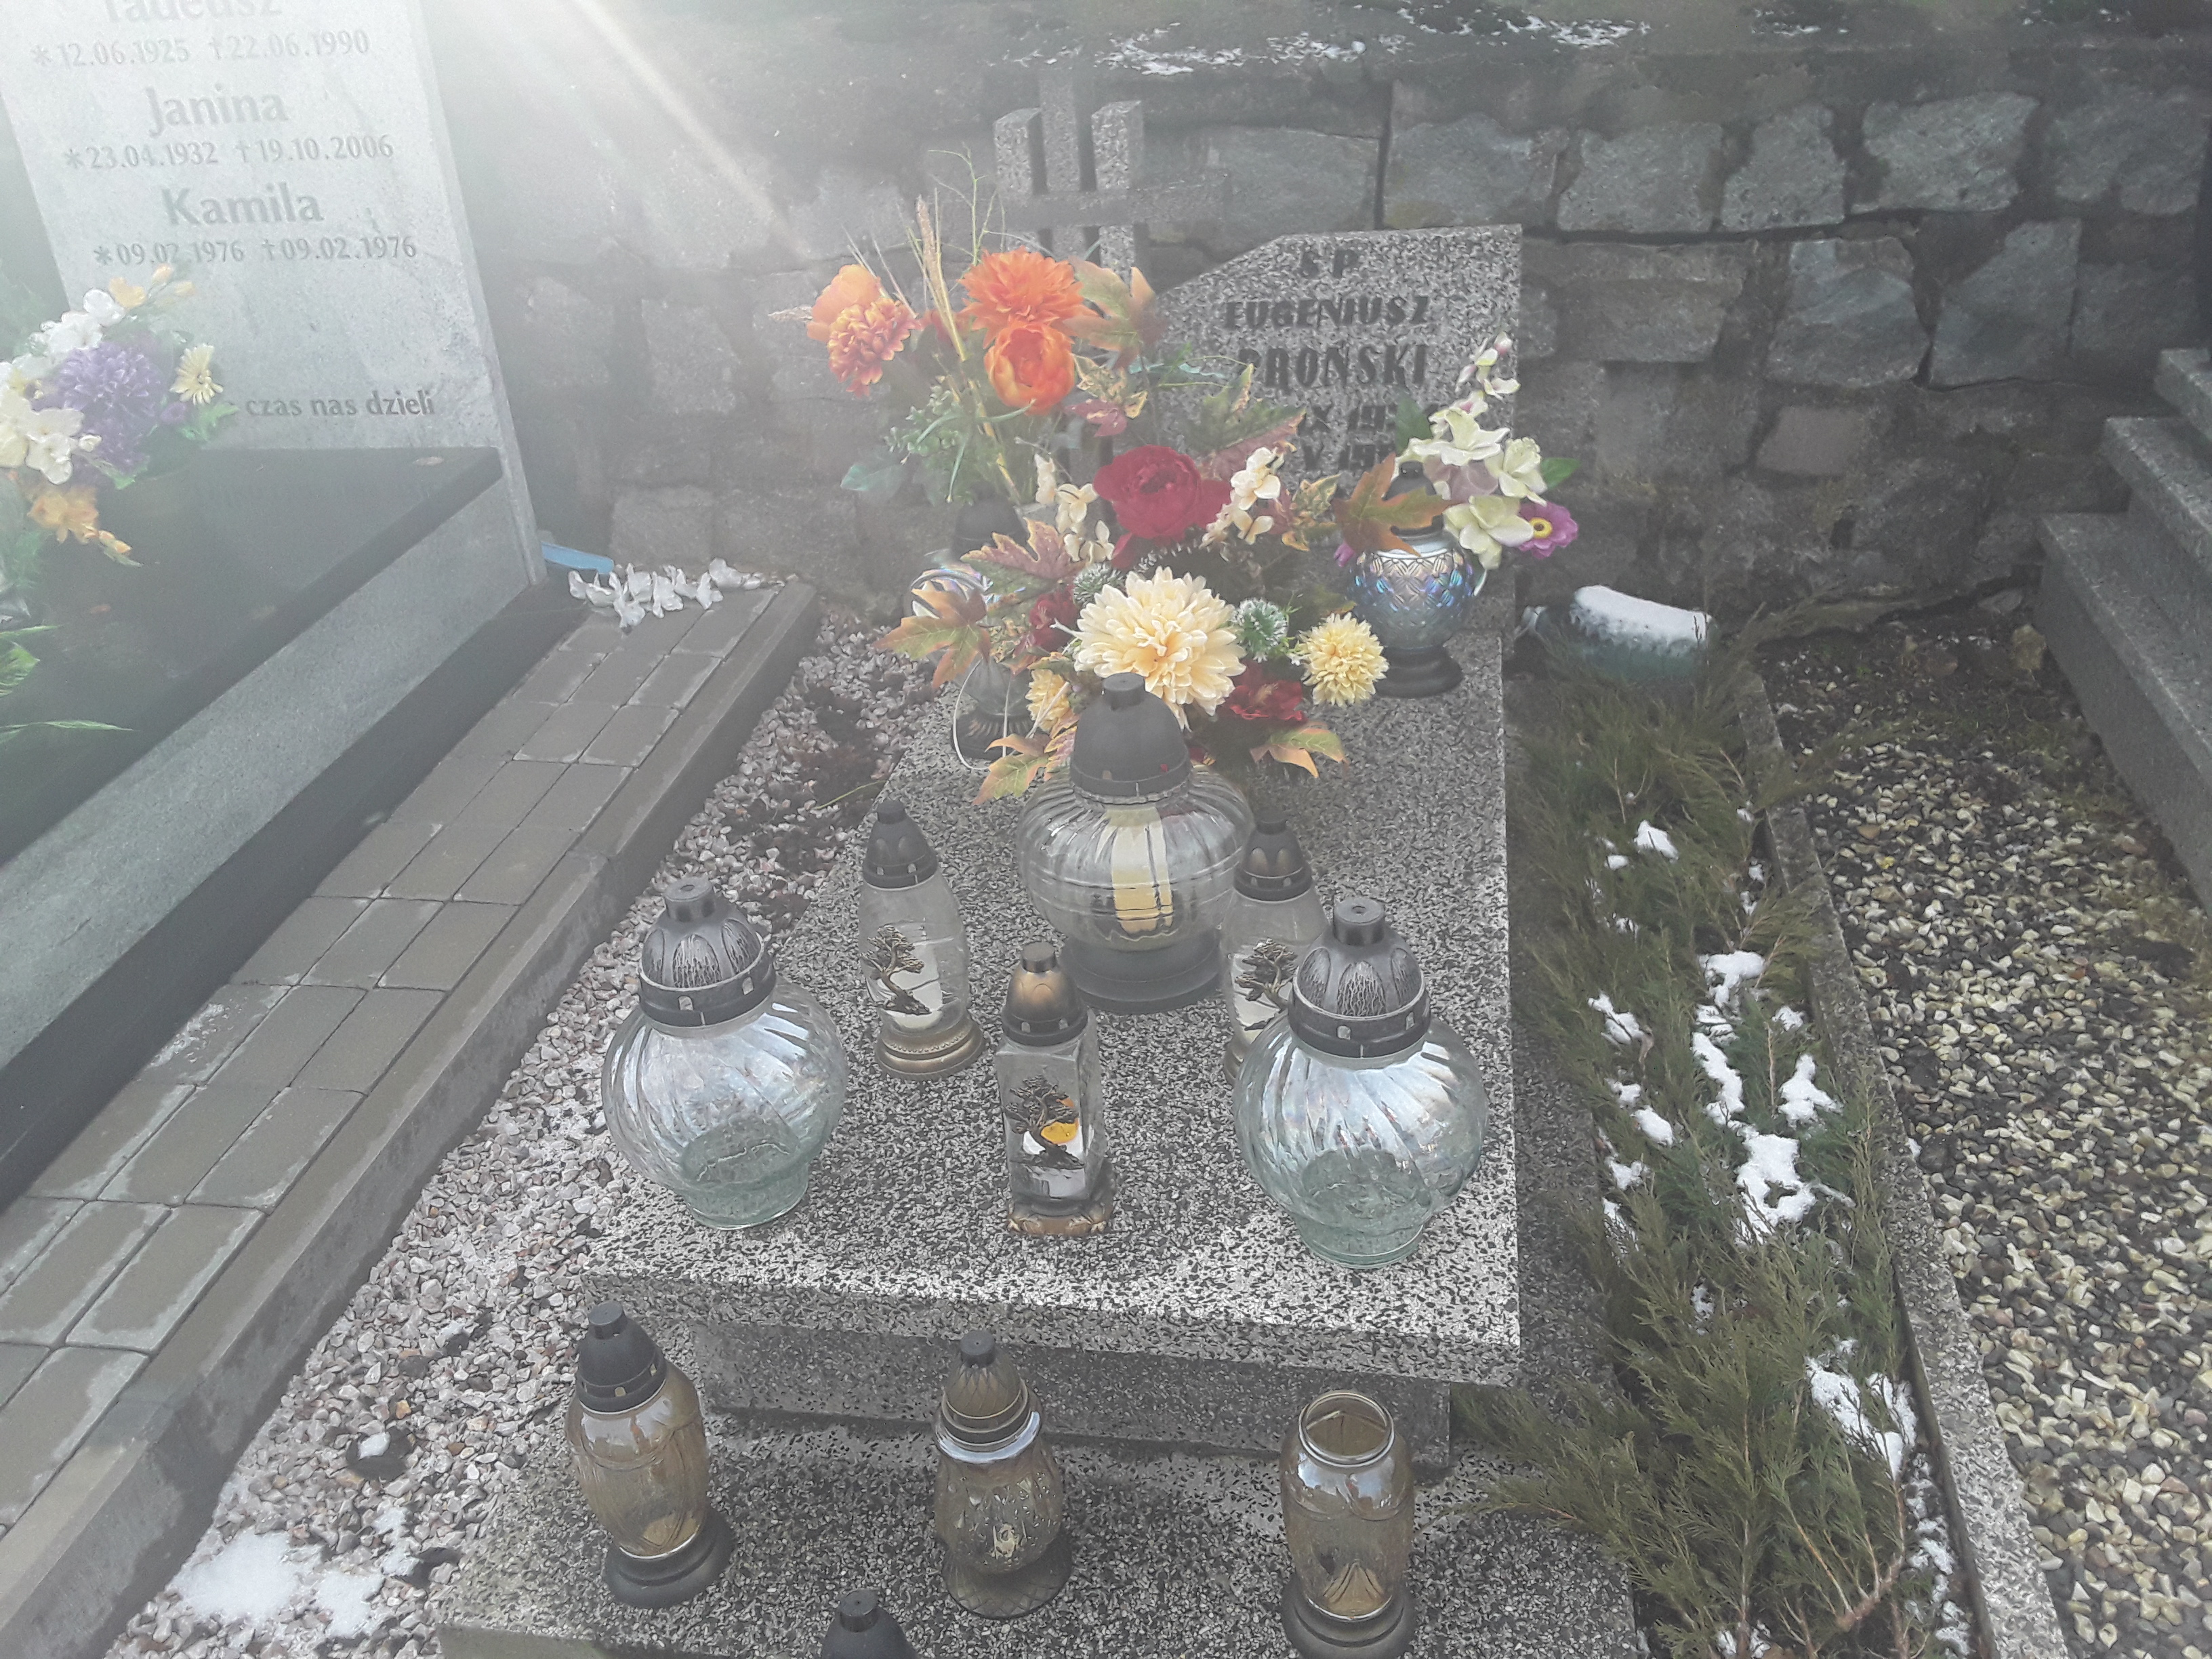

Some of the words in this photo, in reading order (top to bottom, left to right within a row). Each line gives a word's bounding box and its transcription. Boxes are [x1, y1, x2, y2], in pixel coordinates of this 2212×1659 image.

[144, 83, 289, 138] Janina
[161, 182, 325, 226] Kamila
[1224, 295, 1430, 329] EUGENIUSZ
[246, 398, 303, 415] czas
[310, 398, 358, 415] nas
[365, 390, 436, 415] dzieli
